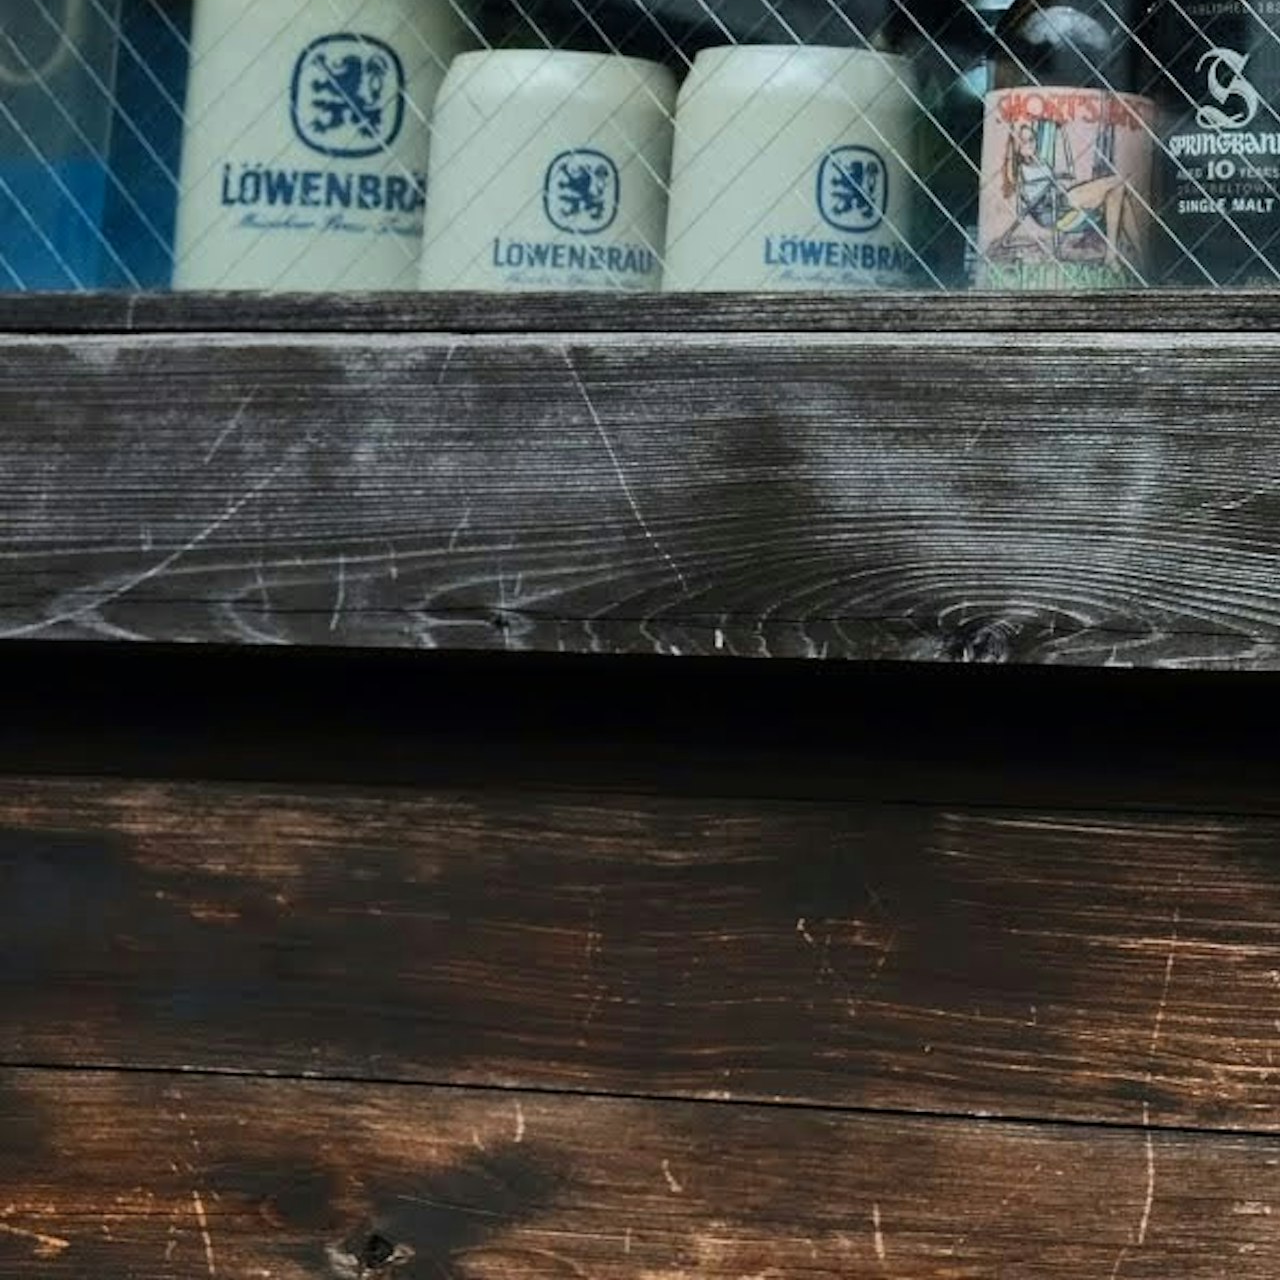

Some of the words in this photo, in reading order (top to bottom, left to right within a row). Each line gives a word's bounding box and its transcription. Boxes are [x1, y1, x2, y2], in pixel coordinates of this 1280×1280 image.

[1206, 159, 1236, 181] 10
[221, 163, 427, 213] LÖWENBRÄ
[1177, 198, 1227, 214] SINGLE
[1230, 198, 1276, 213] MALT
[764, 235, 908, 271] LÖWENBRÄ
